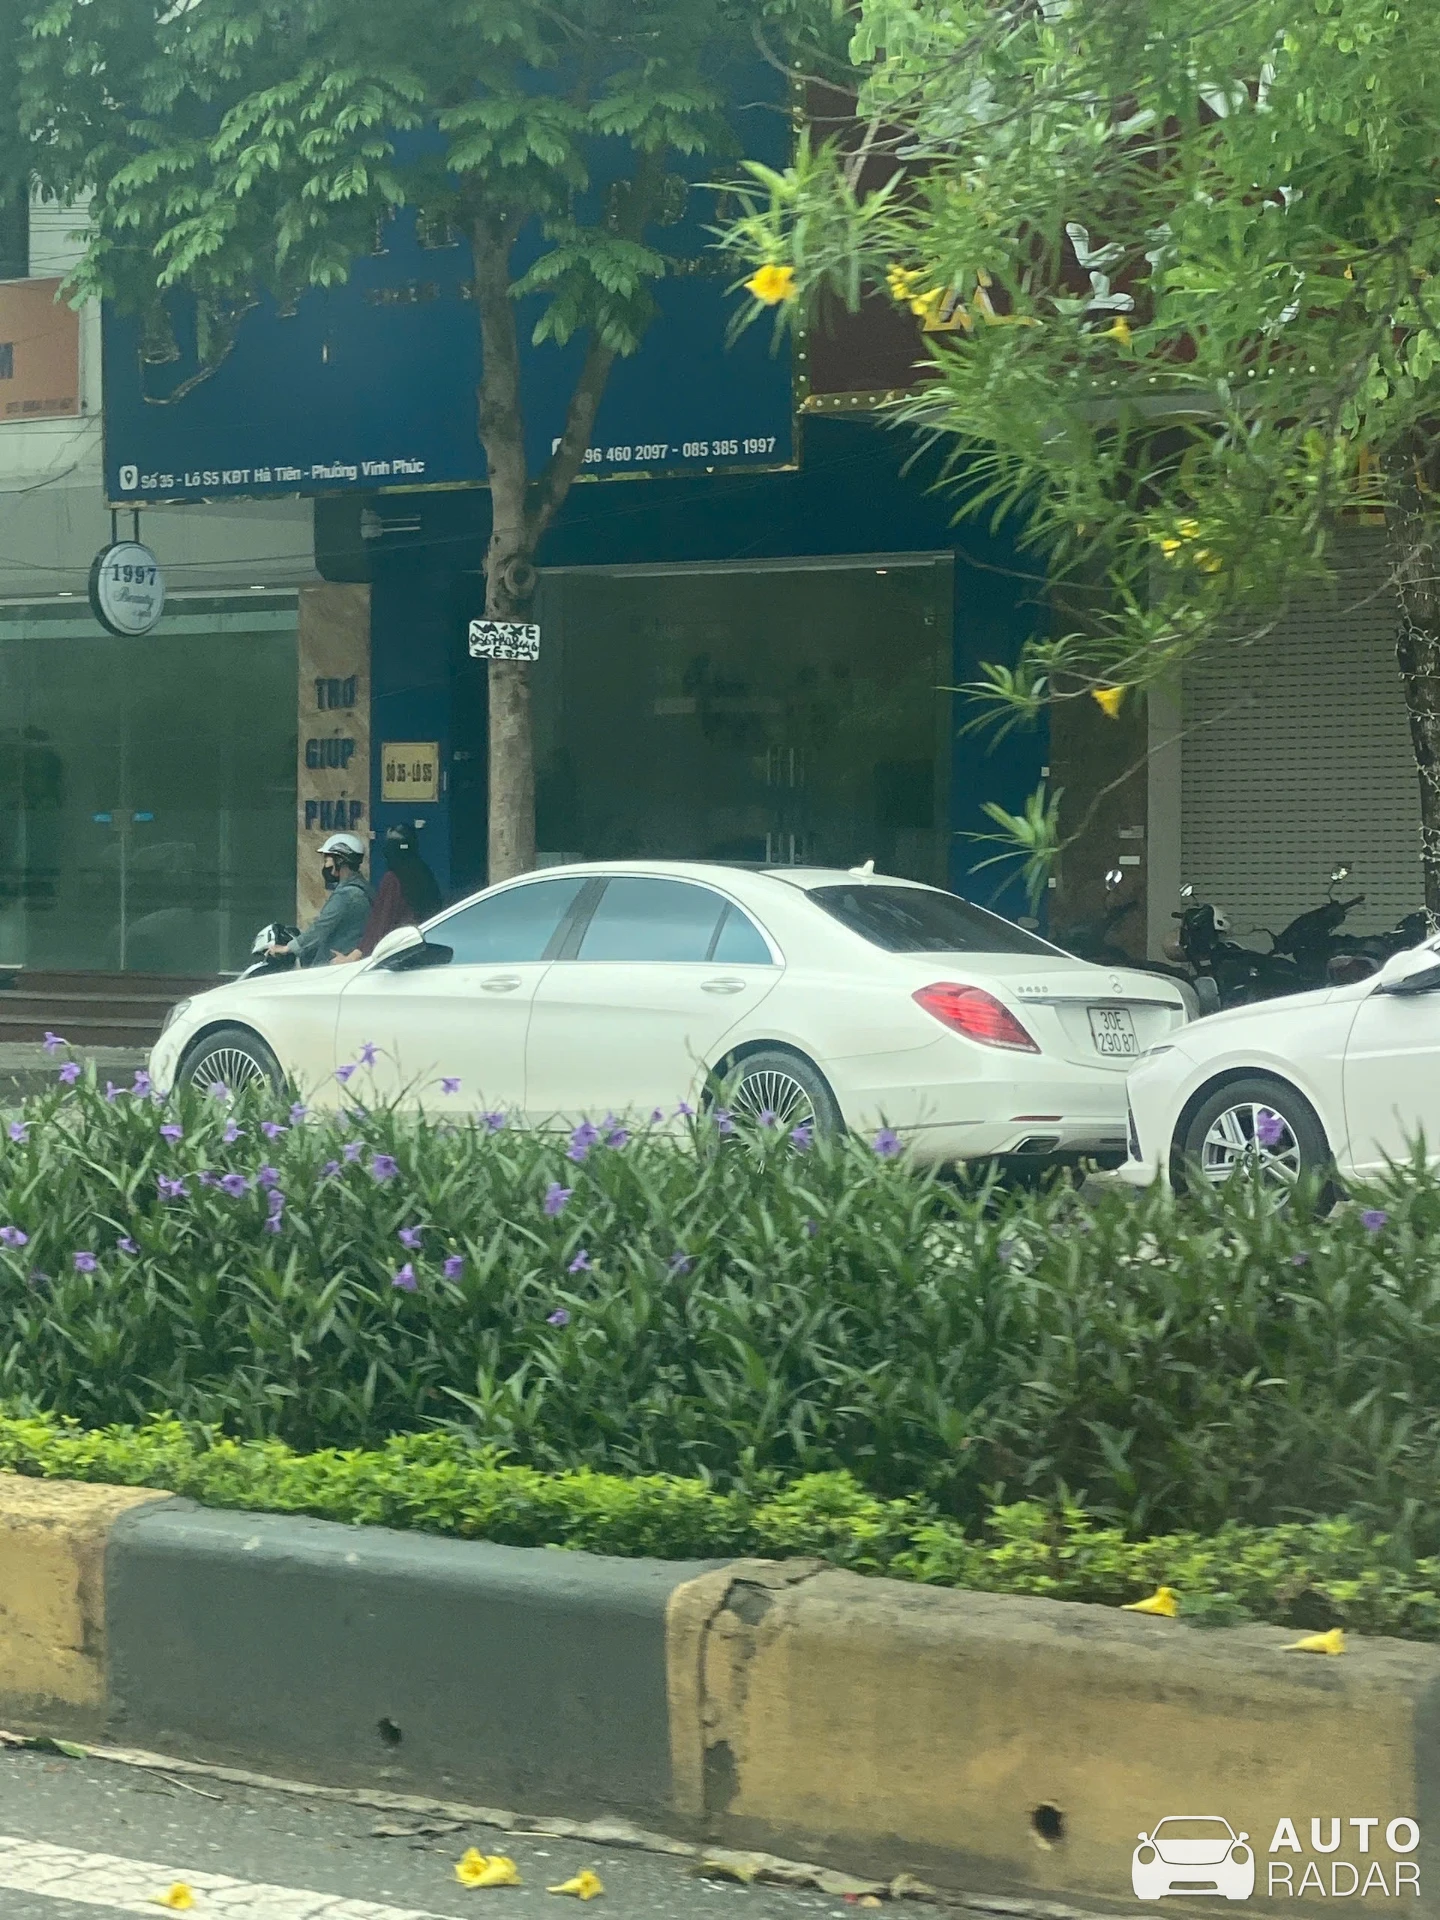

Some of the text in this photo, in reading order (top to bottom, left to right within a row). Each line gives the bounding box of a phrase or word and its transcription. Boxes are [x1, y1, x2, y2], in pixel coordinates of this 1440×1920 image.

[582, 448, 601, 463] 96
[607, 446, 631, 461] 460
[635, 444, 668, 460] 2097
[683, 442, 709, 457] 085
[713, 440, 738, 455] 385
[744, 437, 776, 454] 1997
[141, 472, 157, 489] Số
[159, 475, 173, 488] 35
[203, 471, 219, 486] S5
[222, 469, 250, 484] KĐT
[393, 458, 425, 475] Phúc
[112, 564, 156, 586] 1997
[508, 624, 537, 640] XE
[306, 728, 356, 770] GIÚP
[305, 791, 362, 831] PHÁP
[1100, 1011, 1125, 1031] 30E
[1098, 1032, 1135, 1053] 290.87
